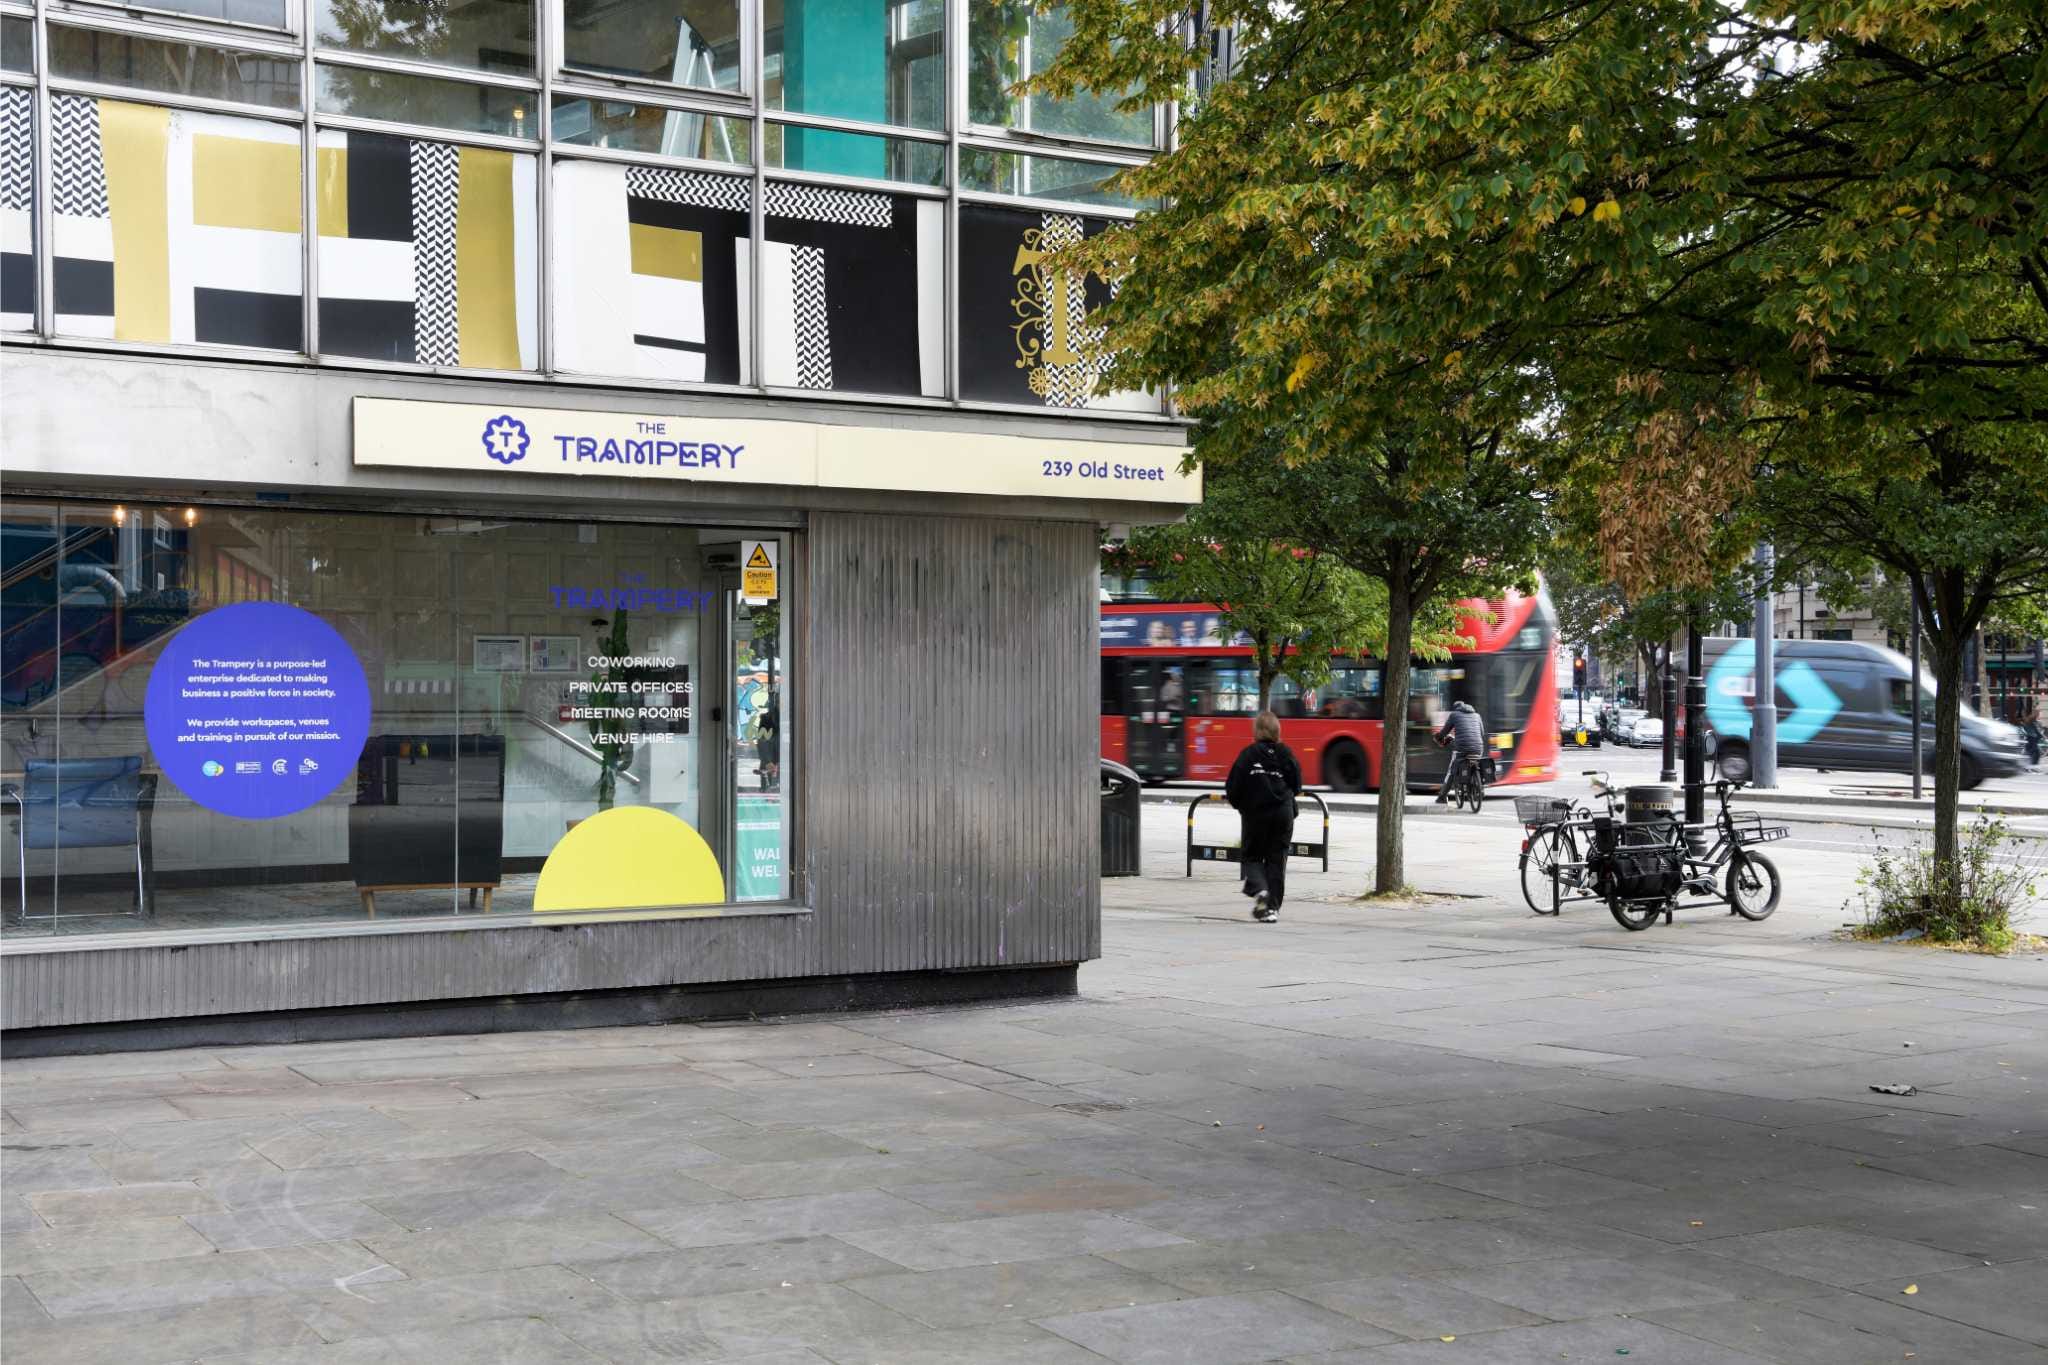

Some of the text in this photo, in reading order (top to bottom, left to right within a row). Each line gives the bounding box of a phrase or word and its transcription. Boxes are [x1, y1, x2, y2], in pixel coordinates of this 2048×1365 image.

[635, 422, 666, 435] THE
[553, 435, 745, 469] TRAMPERY
[1042, 460, 1165, 481] 239 Old Street
[549, 586, 714, 613] TRAMPERY
[192, 659, 210, 668] The
[212, 659, 255, 670] Trampery
[257, 659, 264, 668] is
[273, 659, 326, 670] purpose-led
[587, 656, 676, 668] COWORKING
[188, 674, 328, 684] enterprise dedicated to making
[182, 688, 221, 697] business
[230, 688, 266, 698] positive
[268, 688, 291, 697] force
[292, 688, 301, 696] in
[303, 687, 336, 698] society.
[569, 682, 694, 693] PRIVATE OFFICES
[571, 707, 692, 718] MEETING ROOMS
[187, 718, 203, 727] We
[204, 718, 239, 728] provide
[241, 718, 297, 727] workspaces,
[177, 733, 195, 742] and
[197, 733, 232, 743] training
[234, 733, 243, 741] in
[245, 732, 276, 742] pursuit
[277, 732, 287, 740] of
[305, 732, 341, 740] mission.
[589, 733, 675, 744] VENUE HIRE
